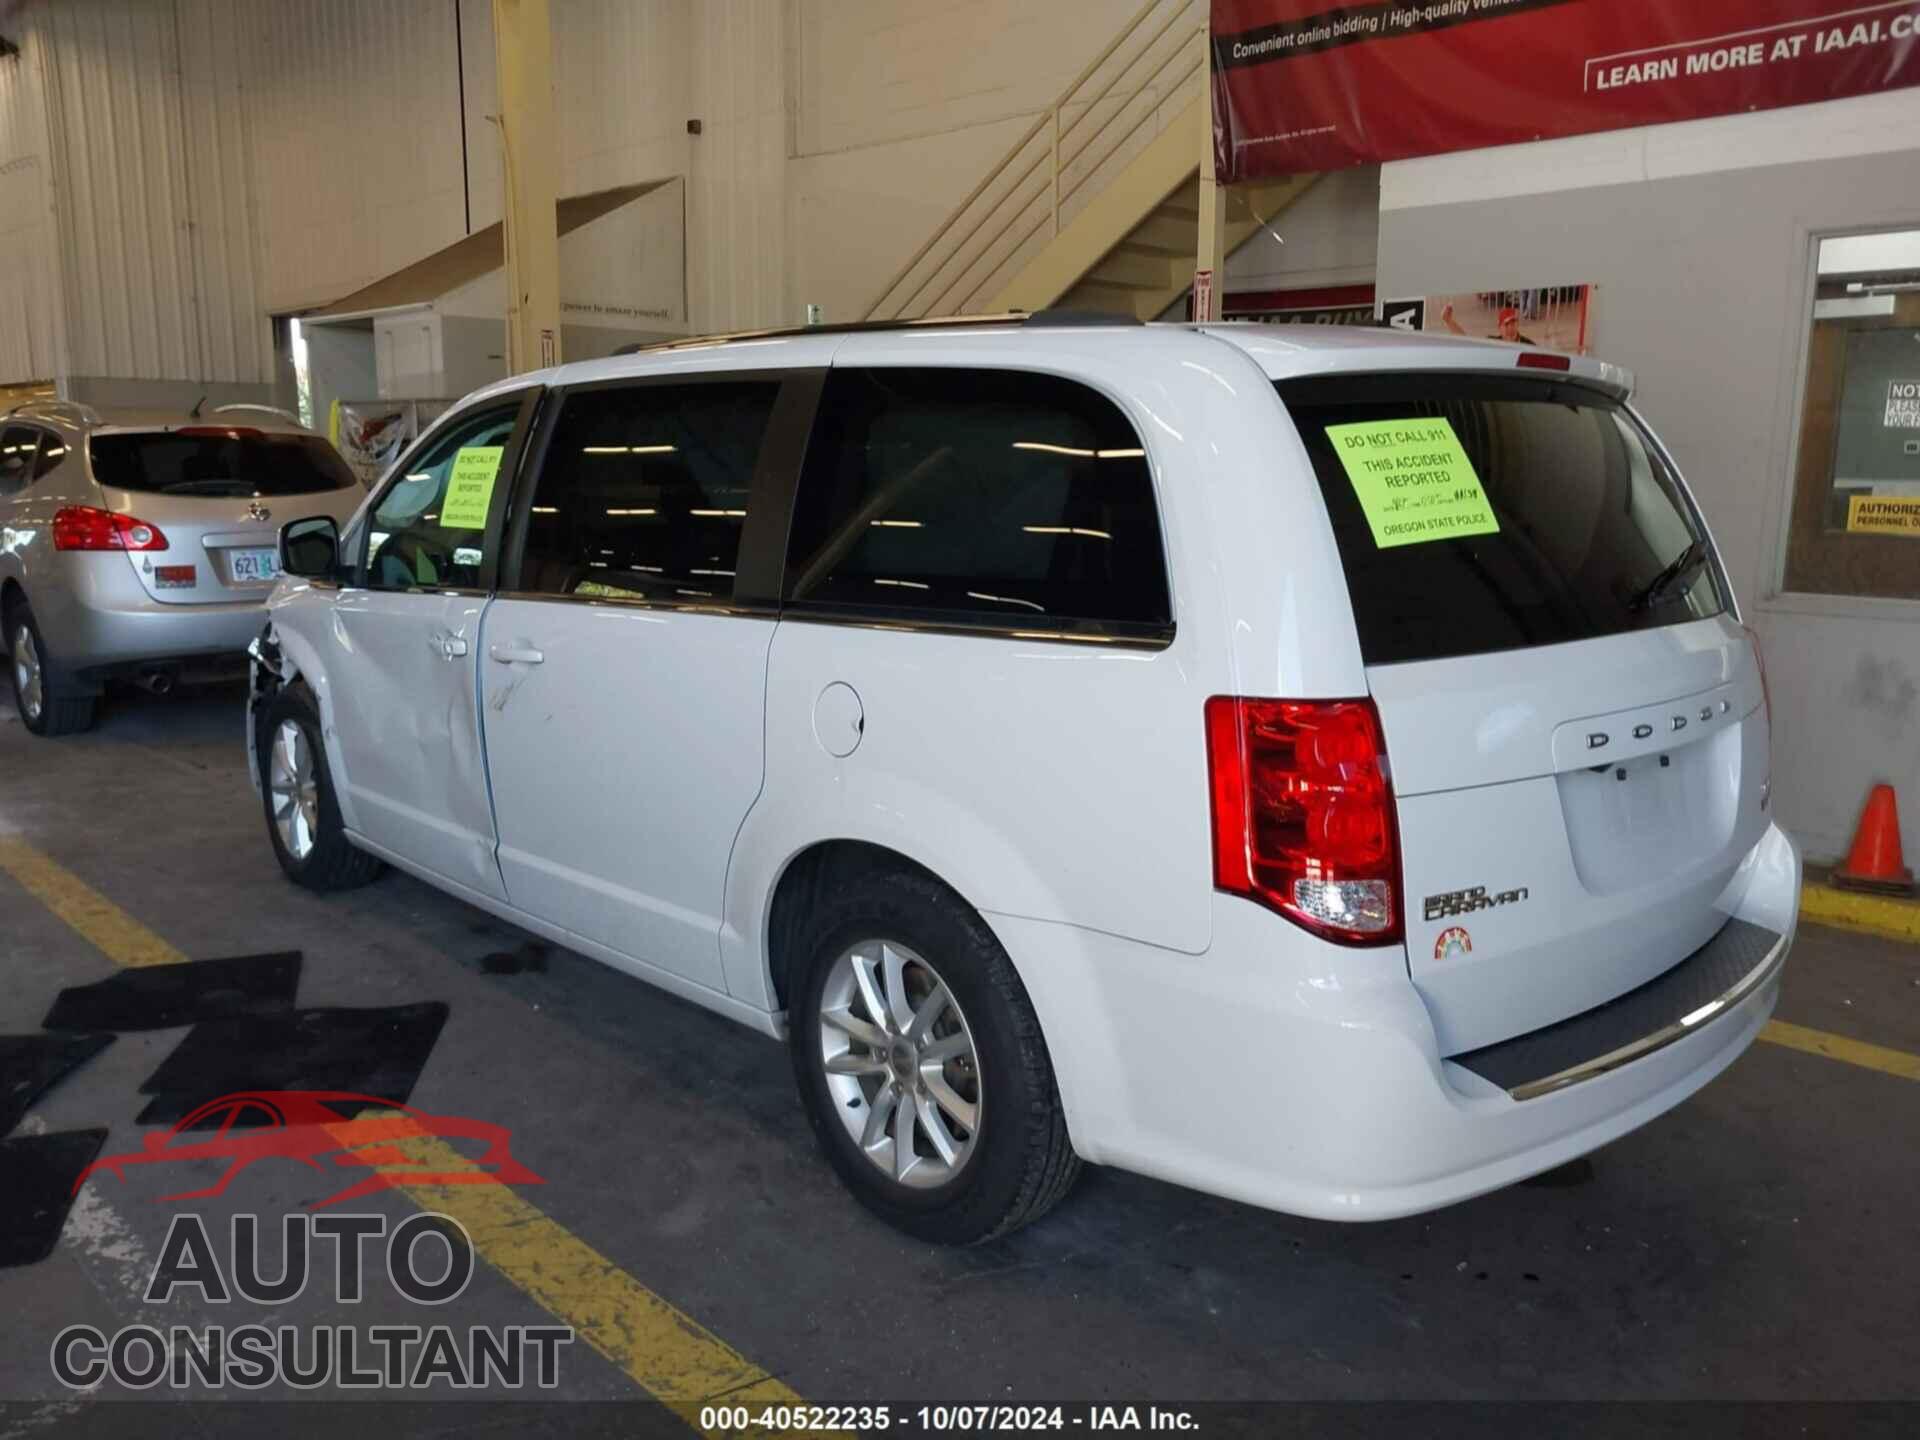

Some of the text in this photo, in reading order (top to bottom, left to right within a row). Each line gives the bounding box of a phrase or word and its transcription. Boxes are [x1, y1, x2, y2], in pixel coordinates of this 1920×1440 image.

[1233, 34, 1294, 58] Convenient
[1297, 25, 1330, 45] online
[1333, 15, 1378, 36] bidding
[1391, 0, 1471, 27] High-quality
[1596, 14, 1920, 90] LEARN MORE AT IAAI.C
[1344, 429, 1447, 449] DO NOT CALL 911
[1362, 453, 1453, 473] THIS ACCIDENT
[1385, 470, 1451, 488] REPORTED
[1383, 513, 1487, 536] OREGON STATE POLICE
[235, 556, 258, 574] 621
